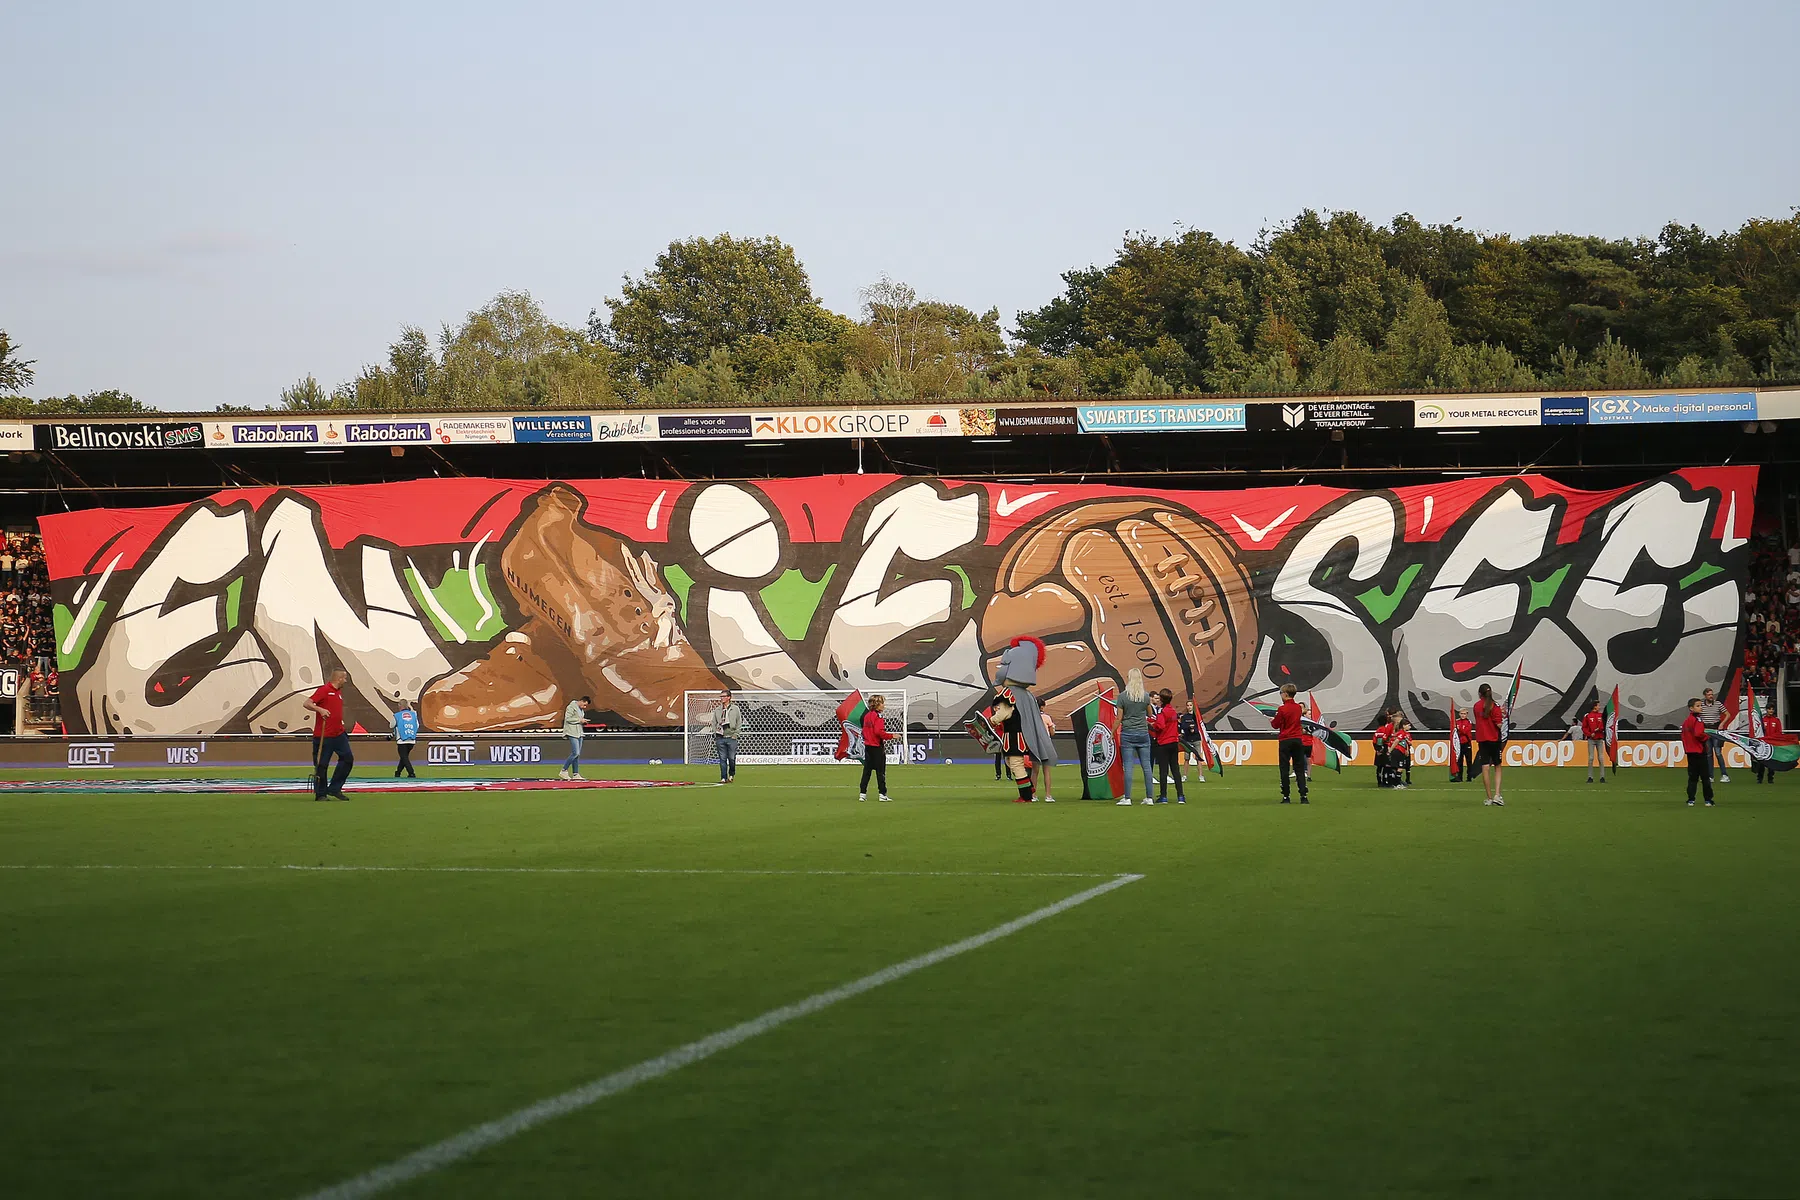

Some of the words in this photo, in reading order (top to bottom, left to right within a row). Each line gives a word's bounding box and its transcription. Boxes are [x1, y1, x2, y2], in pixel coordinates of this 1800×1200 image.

[1086, 409, 1157, 425] SWARTJES
[1159, 407, 1242, 424] TRANSPORT
[1419, 411, 1439, 419] emr
[1448, 410, 1470, 418] YOUR
[1498, 409, 1538, 417] RECYCLER
[1642, 404, 1670, 413] Make
[1673, 403, 1705, 414] digital
[1707, 402, 1754, 413] personal.
[443, 422, 495, 430] RADEMAKERS
[515, 420, 585, 431] WILLEMSEN
[777, 414, 910, 434] KLOKGROEP
[999, 416, 1075, 426] WWW.DESMAAKCATERAAR.NL
[55, 425, 164, 447] Bellnovski
[164, 426, 203, 446] SMS
[237, 425, 314, 442] Rabobank
[351, 424, 427, 441] Rabobank
[661, 427, 706, 436] professionele
[706, 427, 750, 435] schoonmaak
[1099, 575, 1129, 609] est.
[508, 567, 571, 637] NIJMEGEN
[1121, 618, 1164, 679] 1900
[68, 746, 115, 765] WBT
[428, 745, 475, 763] WBT
[490, 746, 541, 762] WESTB
[1506, 741, 1575, 767] coop
[1617, 741, 1685, 767] coop
